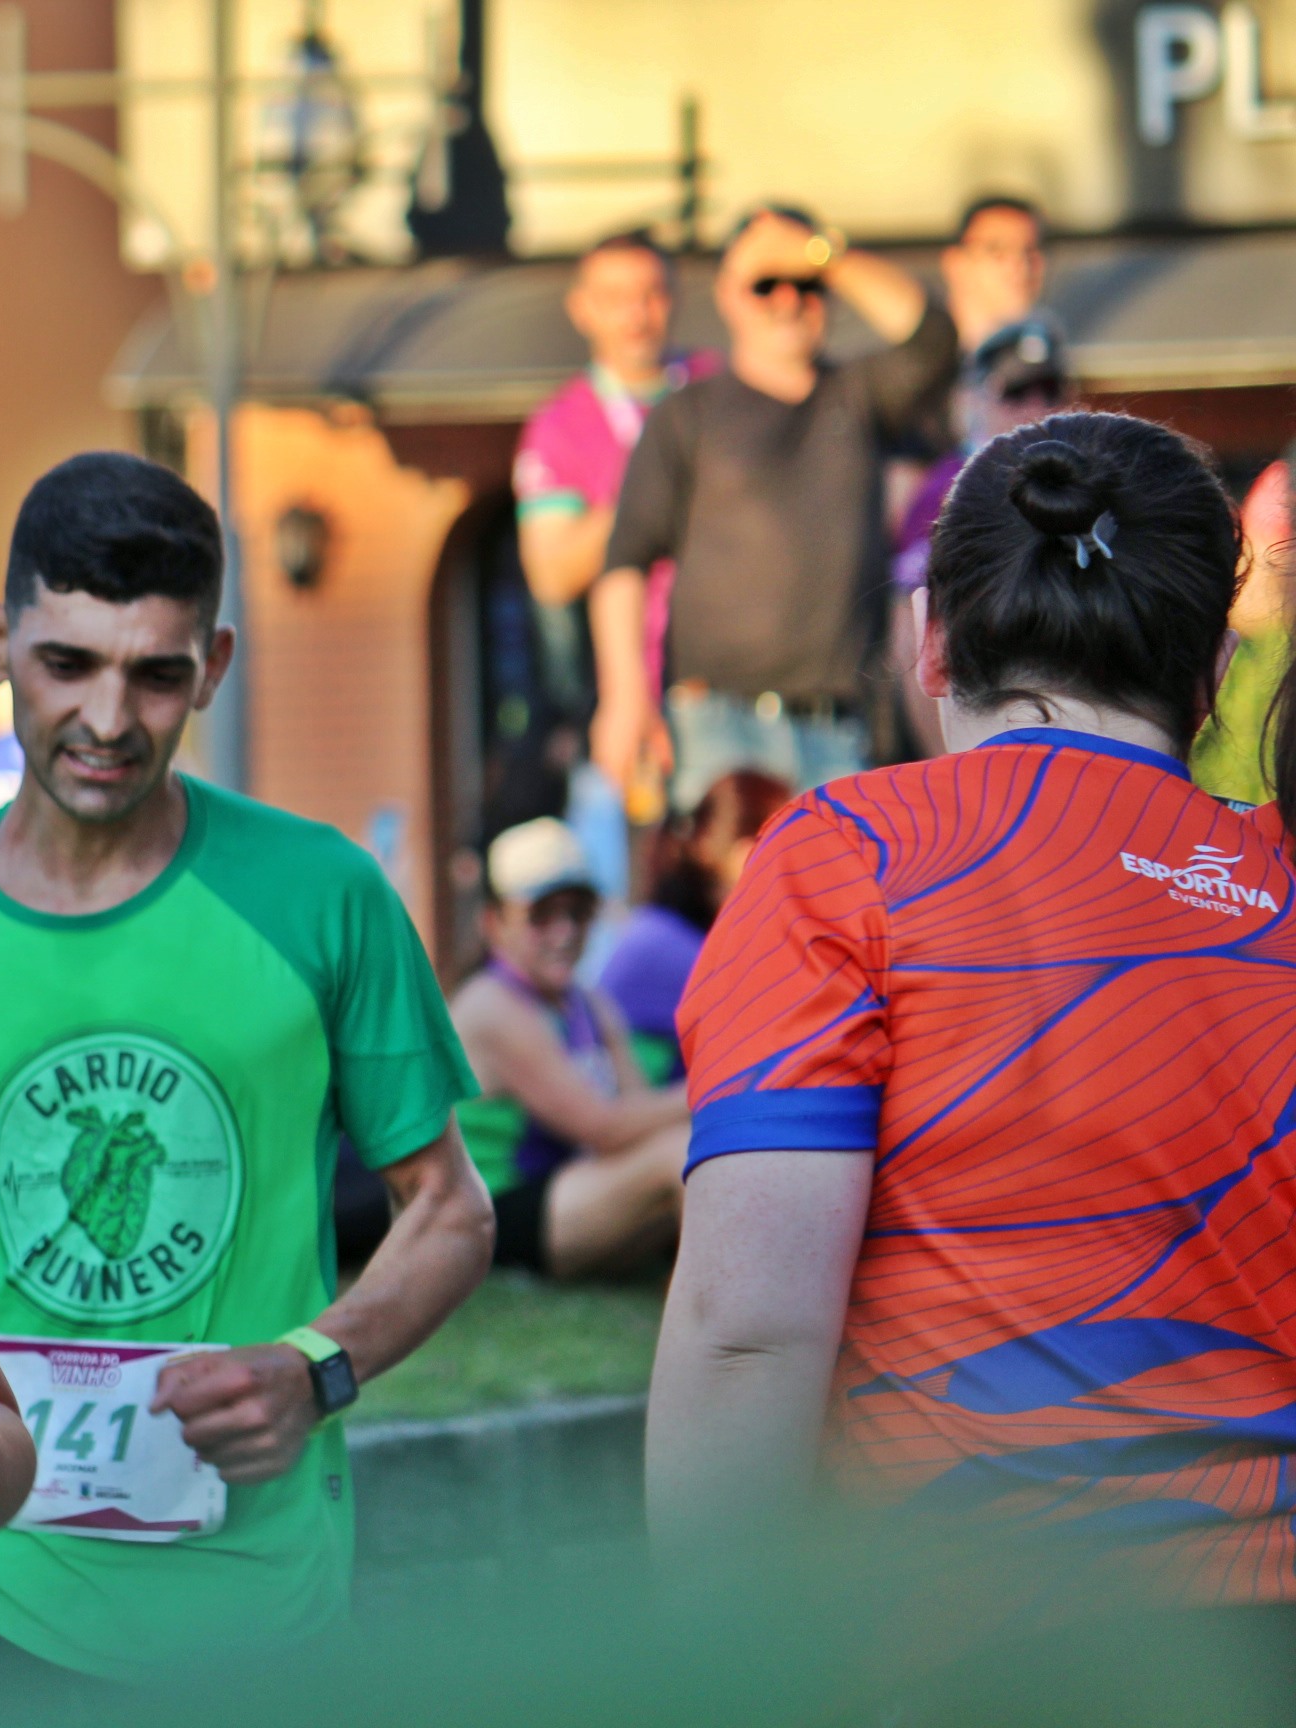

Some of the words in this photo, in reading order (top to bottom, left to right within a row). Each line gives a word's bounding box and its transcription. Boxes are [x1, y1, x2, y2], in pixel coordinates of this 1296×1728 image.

[1120, 852, 1279, 913] ESPORTIVA
[1168, 889, 1243, 917] EVENTOS
[25, 1052, 180, 1118] CARDIO
[23, 1222, 205, 1301] RUNNERS
[51, 1365, 122, 1388] VINHO
[26, 1399, 138, 1462] 141
